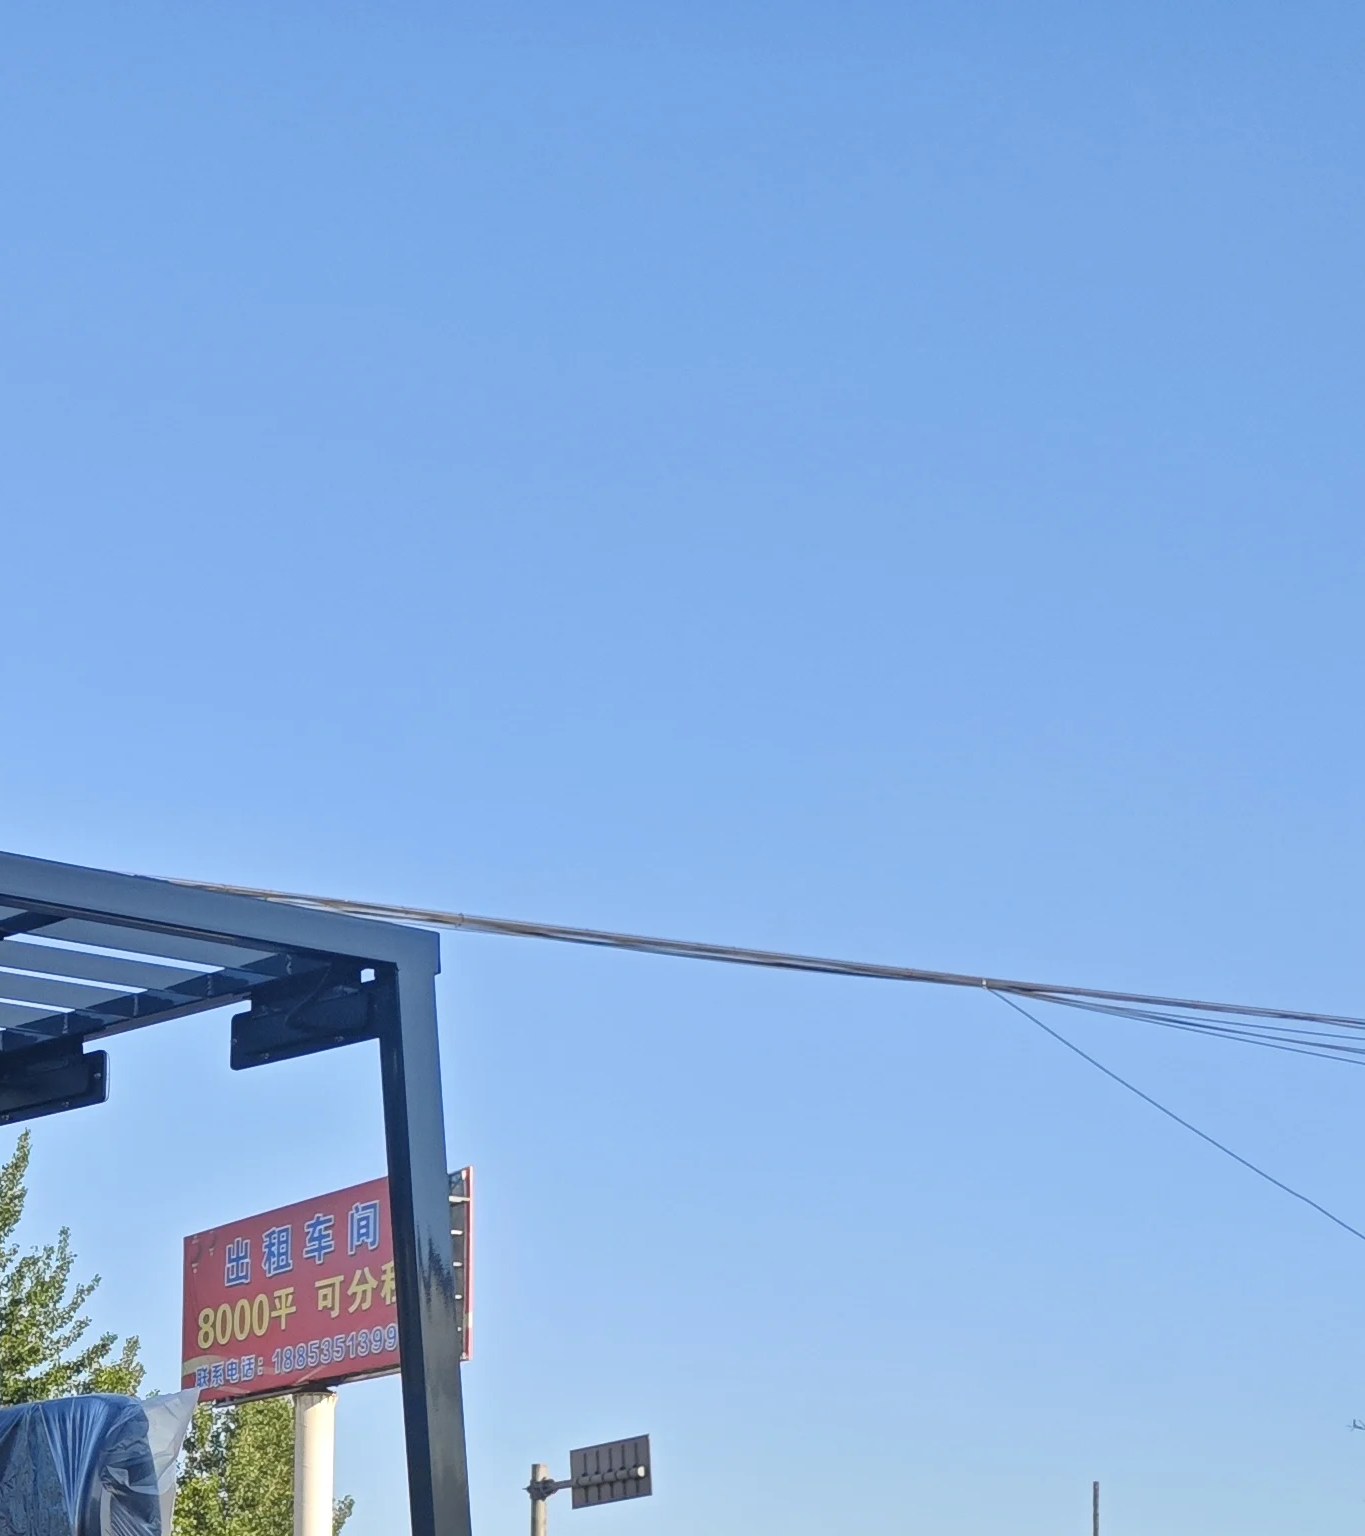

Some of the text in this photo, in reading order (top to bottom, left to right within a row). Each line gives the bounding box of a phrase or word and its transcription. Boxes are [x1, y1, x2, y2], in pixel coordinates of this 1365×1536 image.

[224, 1199, 380, 1287] 出租车间
[197, 1286, 297, 1349] 8000平
